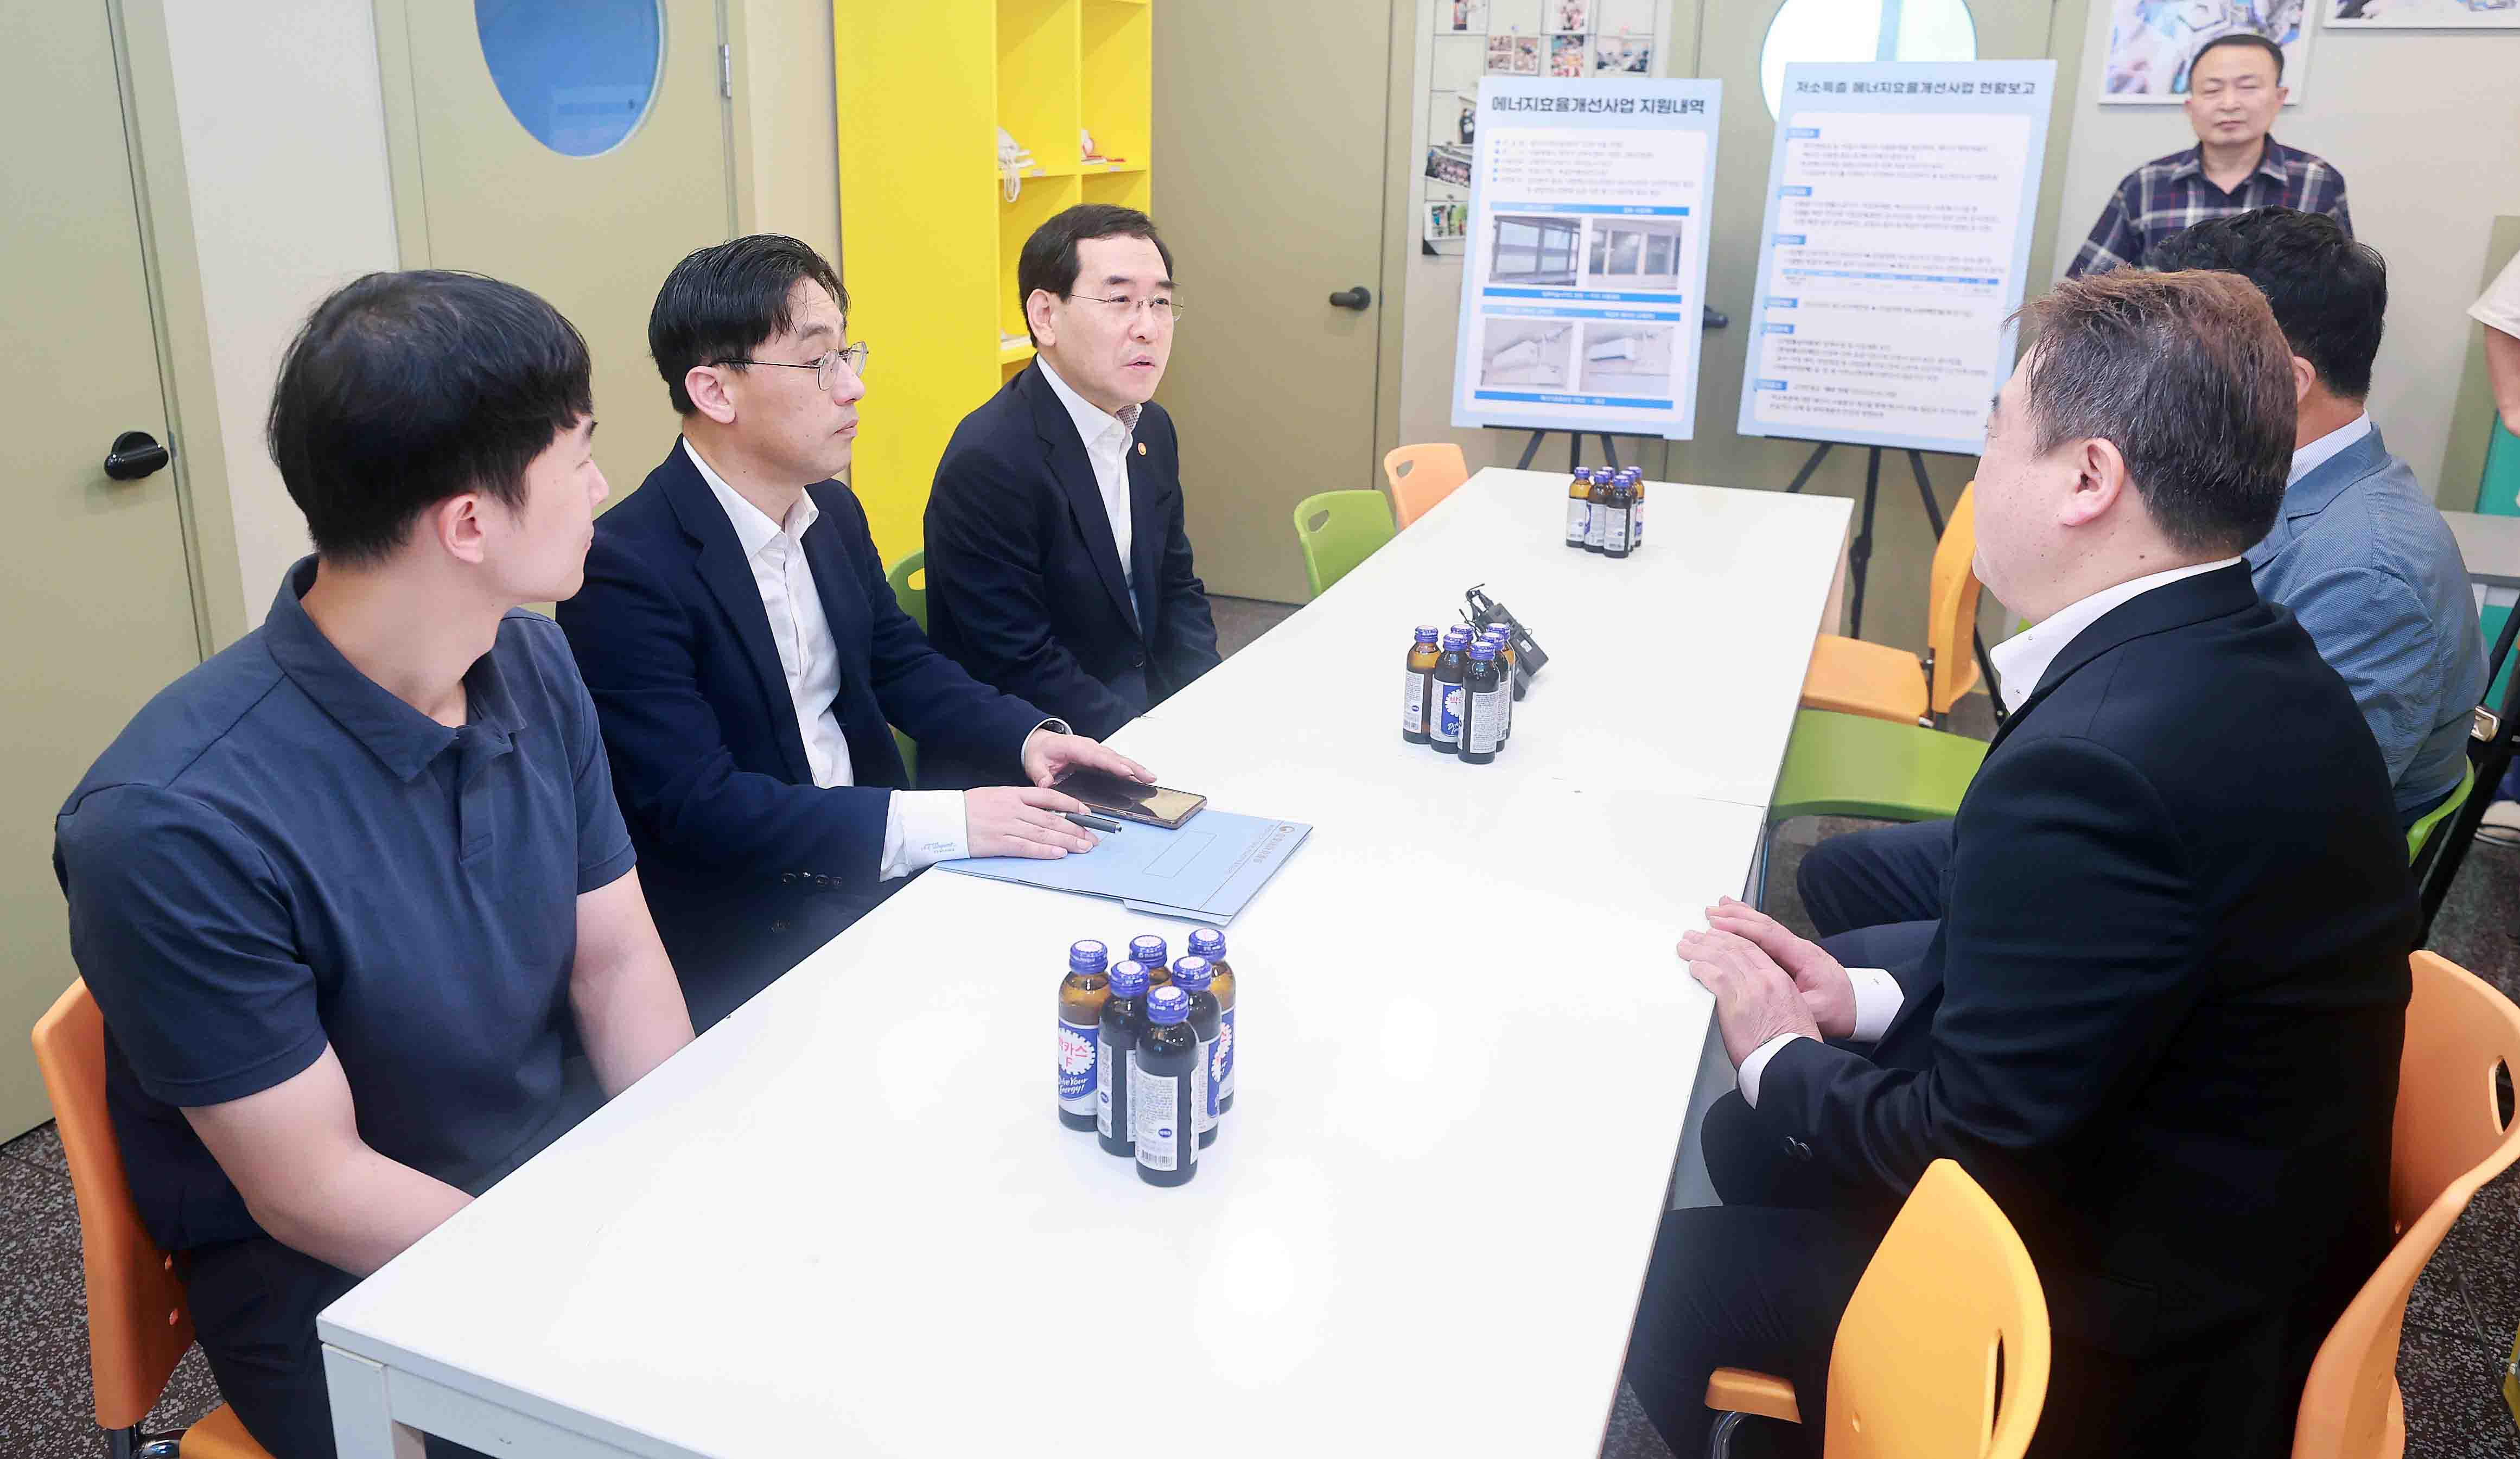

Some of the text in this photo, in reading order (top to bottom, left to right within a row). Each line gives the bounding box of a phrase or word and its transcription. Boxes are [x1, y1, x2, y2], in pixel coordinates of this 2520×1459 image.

[1493, 96, 1704, 114] 에너지효율개선사업 지원내역
[1066, 1057, 1073, 1068] F
[1070, 1076, 1089, 1086] Your
